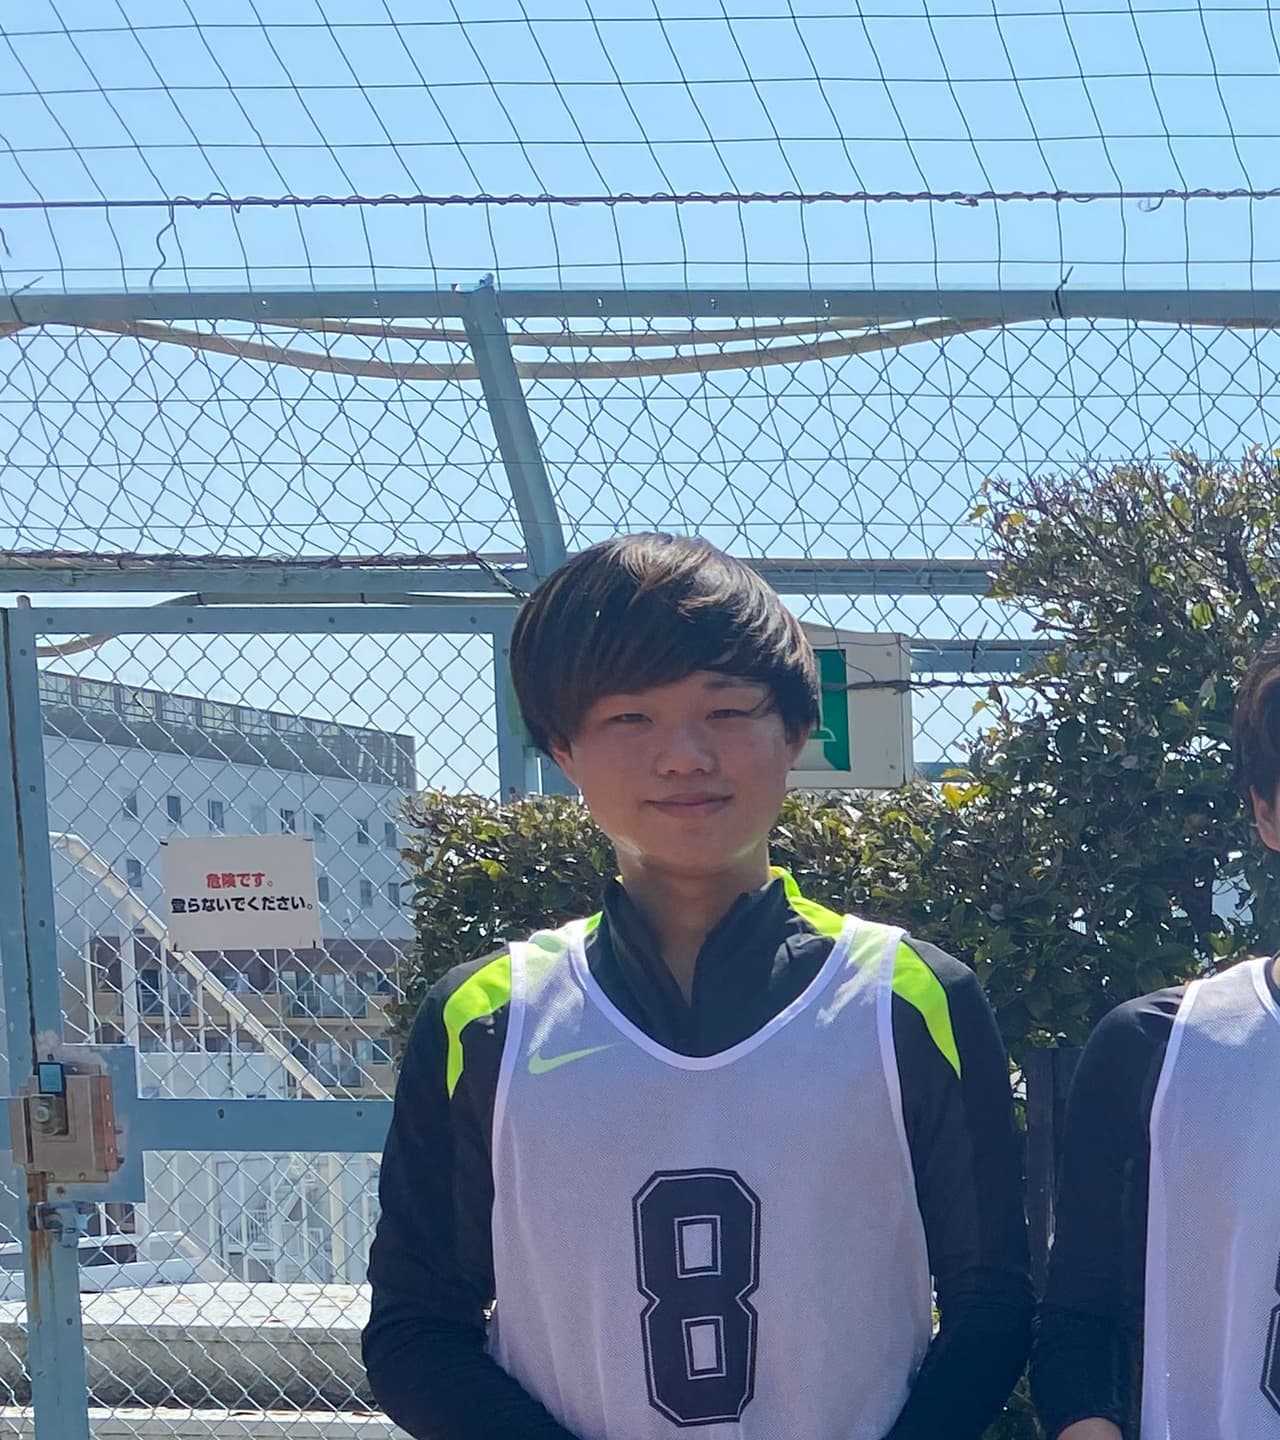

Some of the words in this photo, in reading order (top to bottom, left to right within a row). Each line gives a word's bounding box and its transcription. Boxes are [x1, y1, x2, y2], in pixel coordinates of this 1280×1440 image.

[206, 872, 273, 889] 危険です。
[171, 896, 313, 914] 登らないでください。
[632, 1168, 762, 1428] 8
